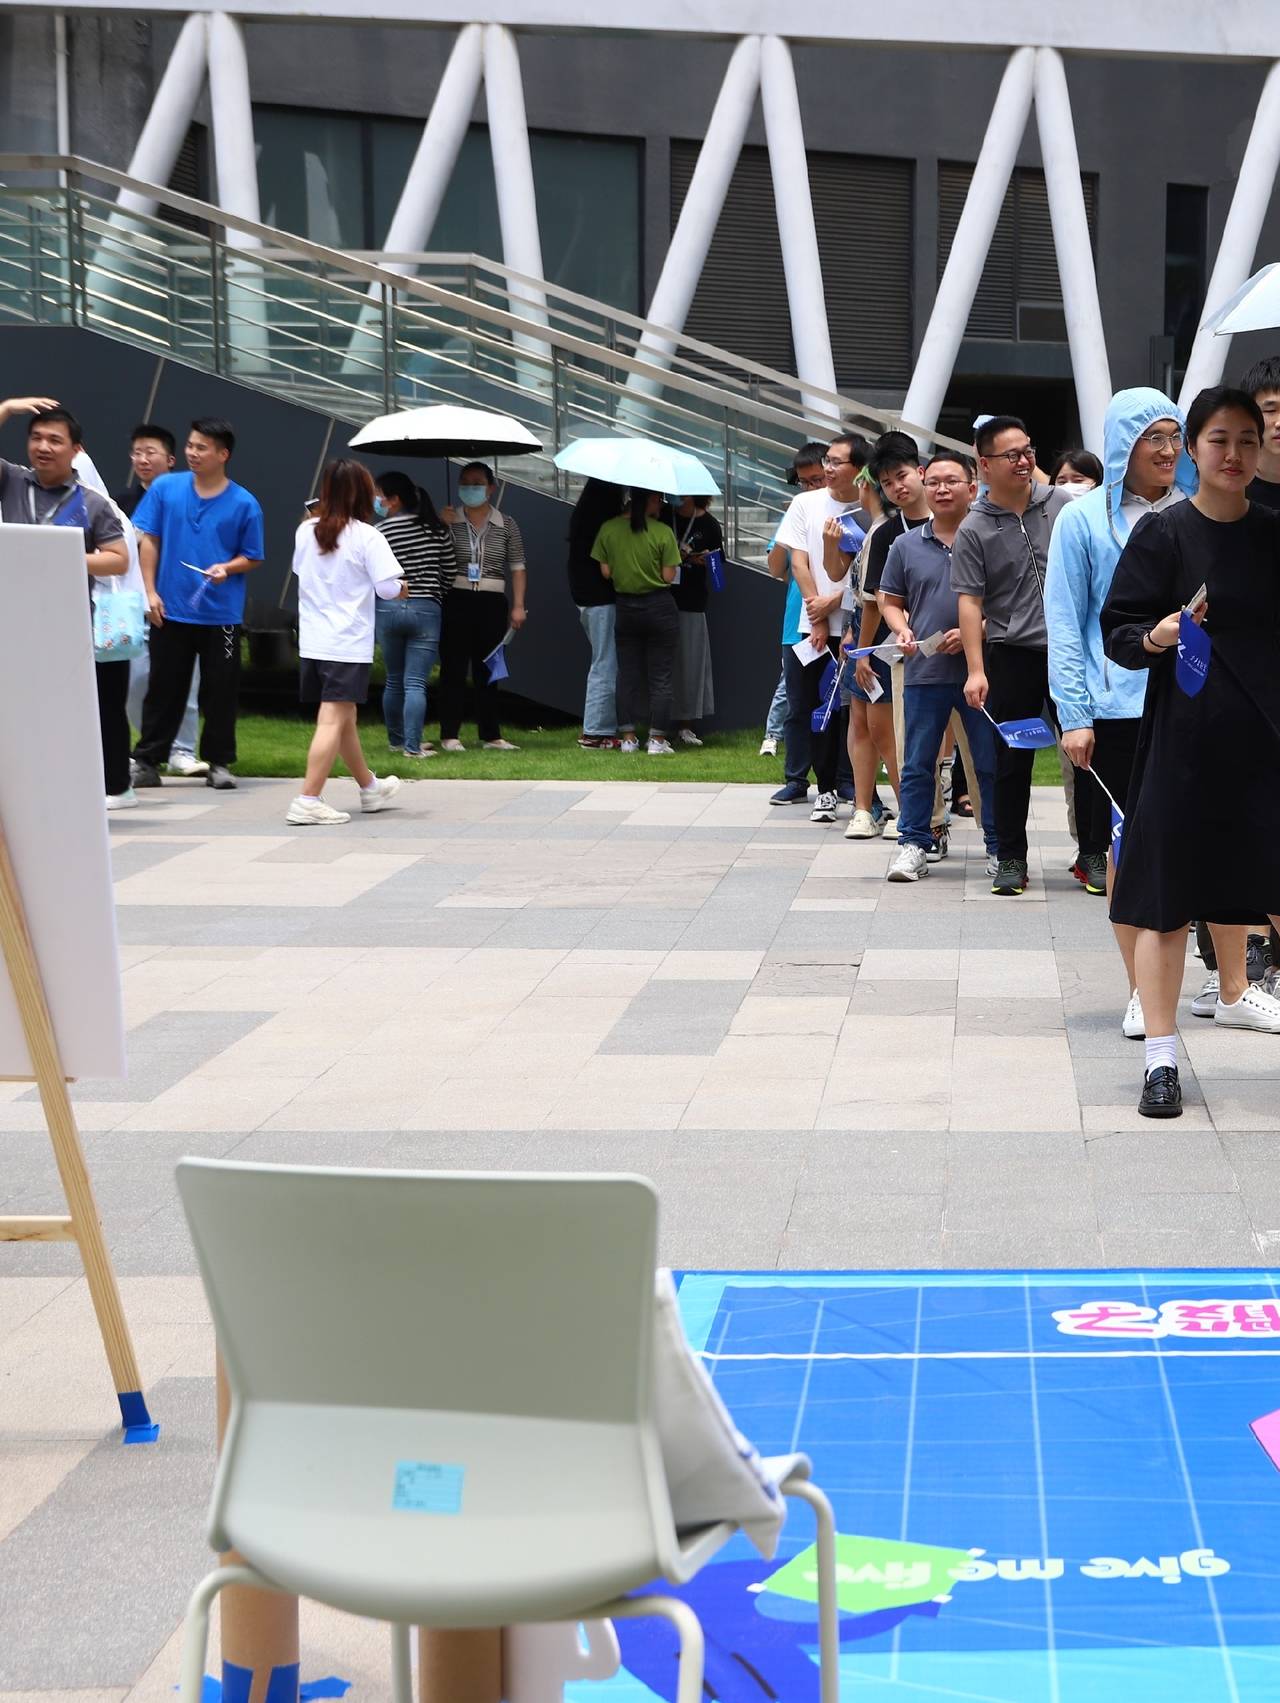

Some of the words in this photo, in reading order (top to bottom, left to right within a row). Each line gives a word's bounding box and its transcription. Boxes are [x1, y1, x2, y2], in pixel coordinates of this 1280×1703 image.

[802, 1560, 932, 1590] five
[947, 1558, 1065, 1582] me
[1080, 1548, 1230, 1585] give
